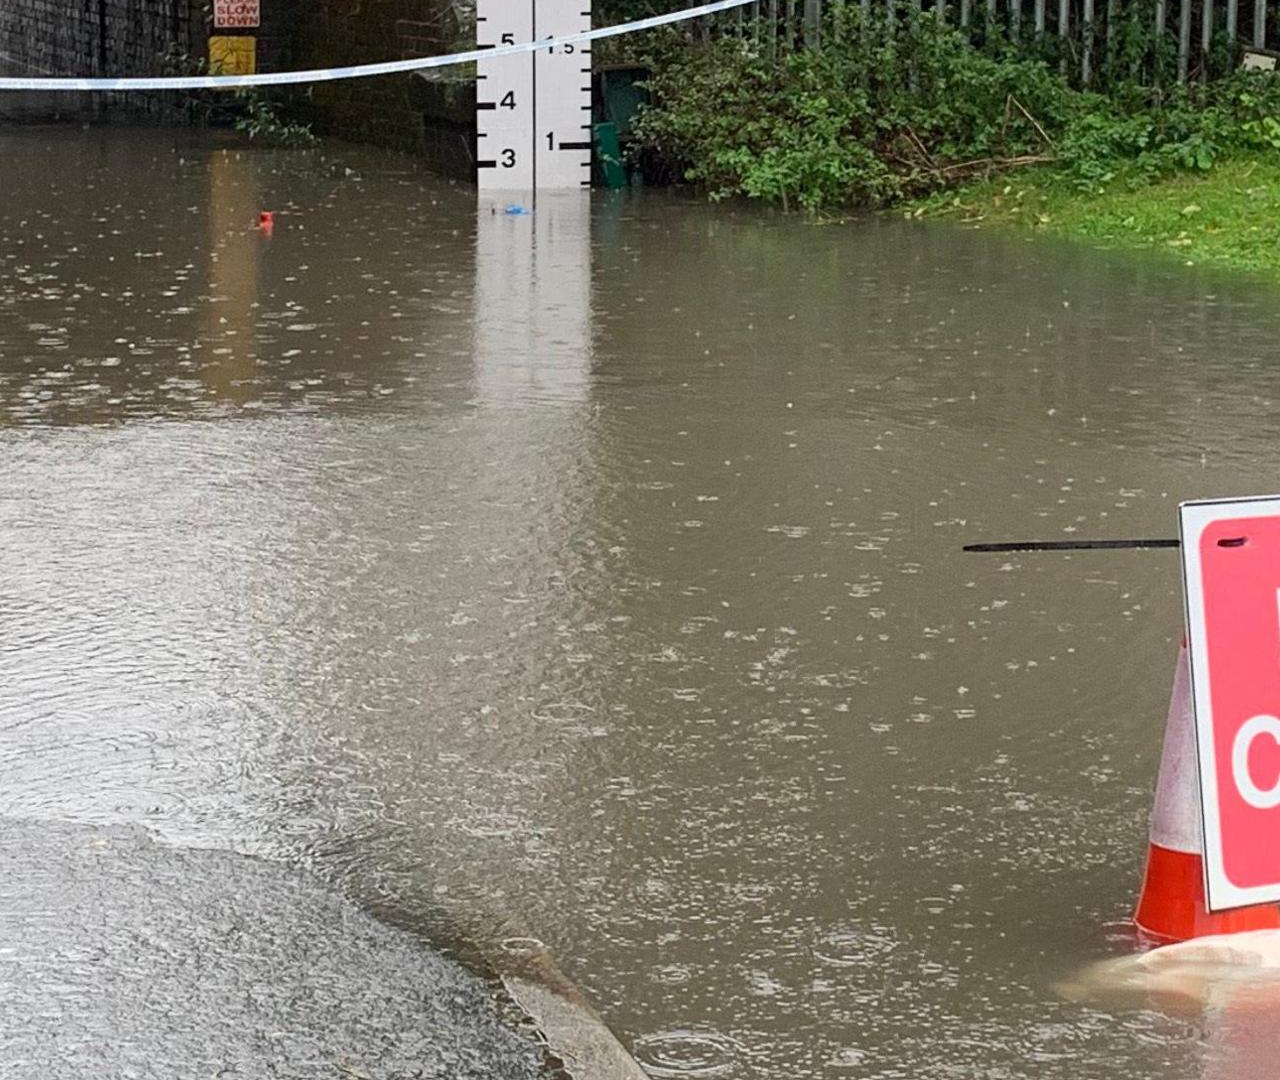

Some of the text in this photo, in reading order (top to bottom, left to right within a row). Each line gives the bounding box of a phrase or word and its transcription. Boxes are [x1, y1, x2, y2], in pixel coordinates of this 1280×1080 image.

[216, 3, 258, 15] SLOW
[216, 15, 259, 26] DOWN
[501, 33, 515, 46] 5
[499, 90, 517, 110] 4
[545, 131, 554, 151] 1
[500, 148, 516, 169] 3
